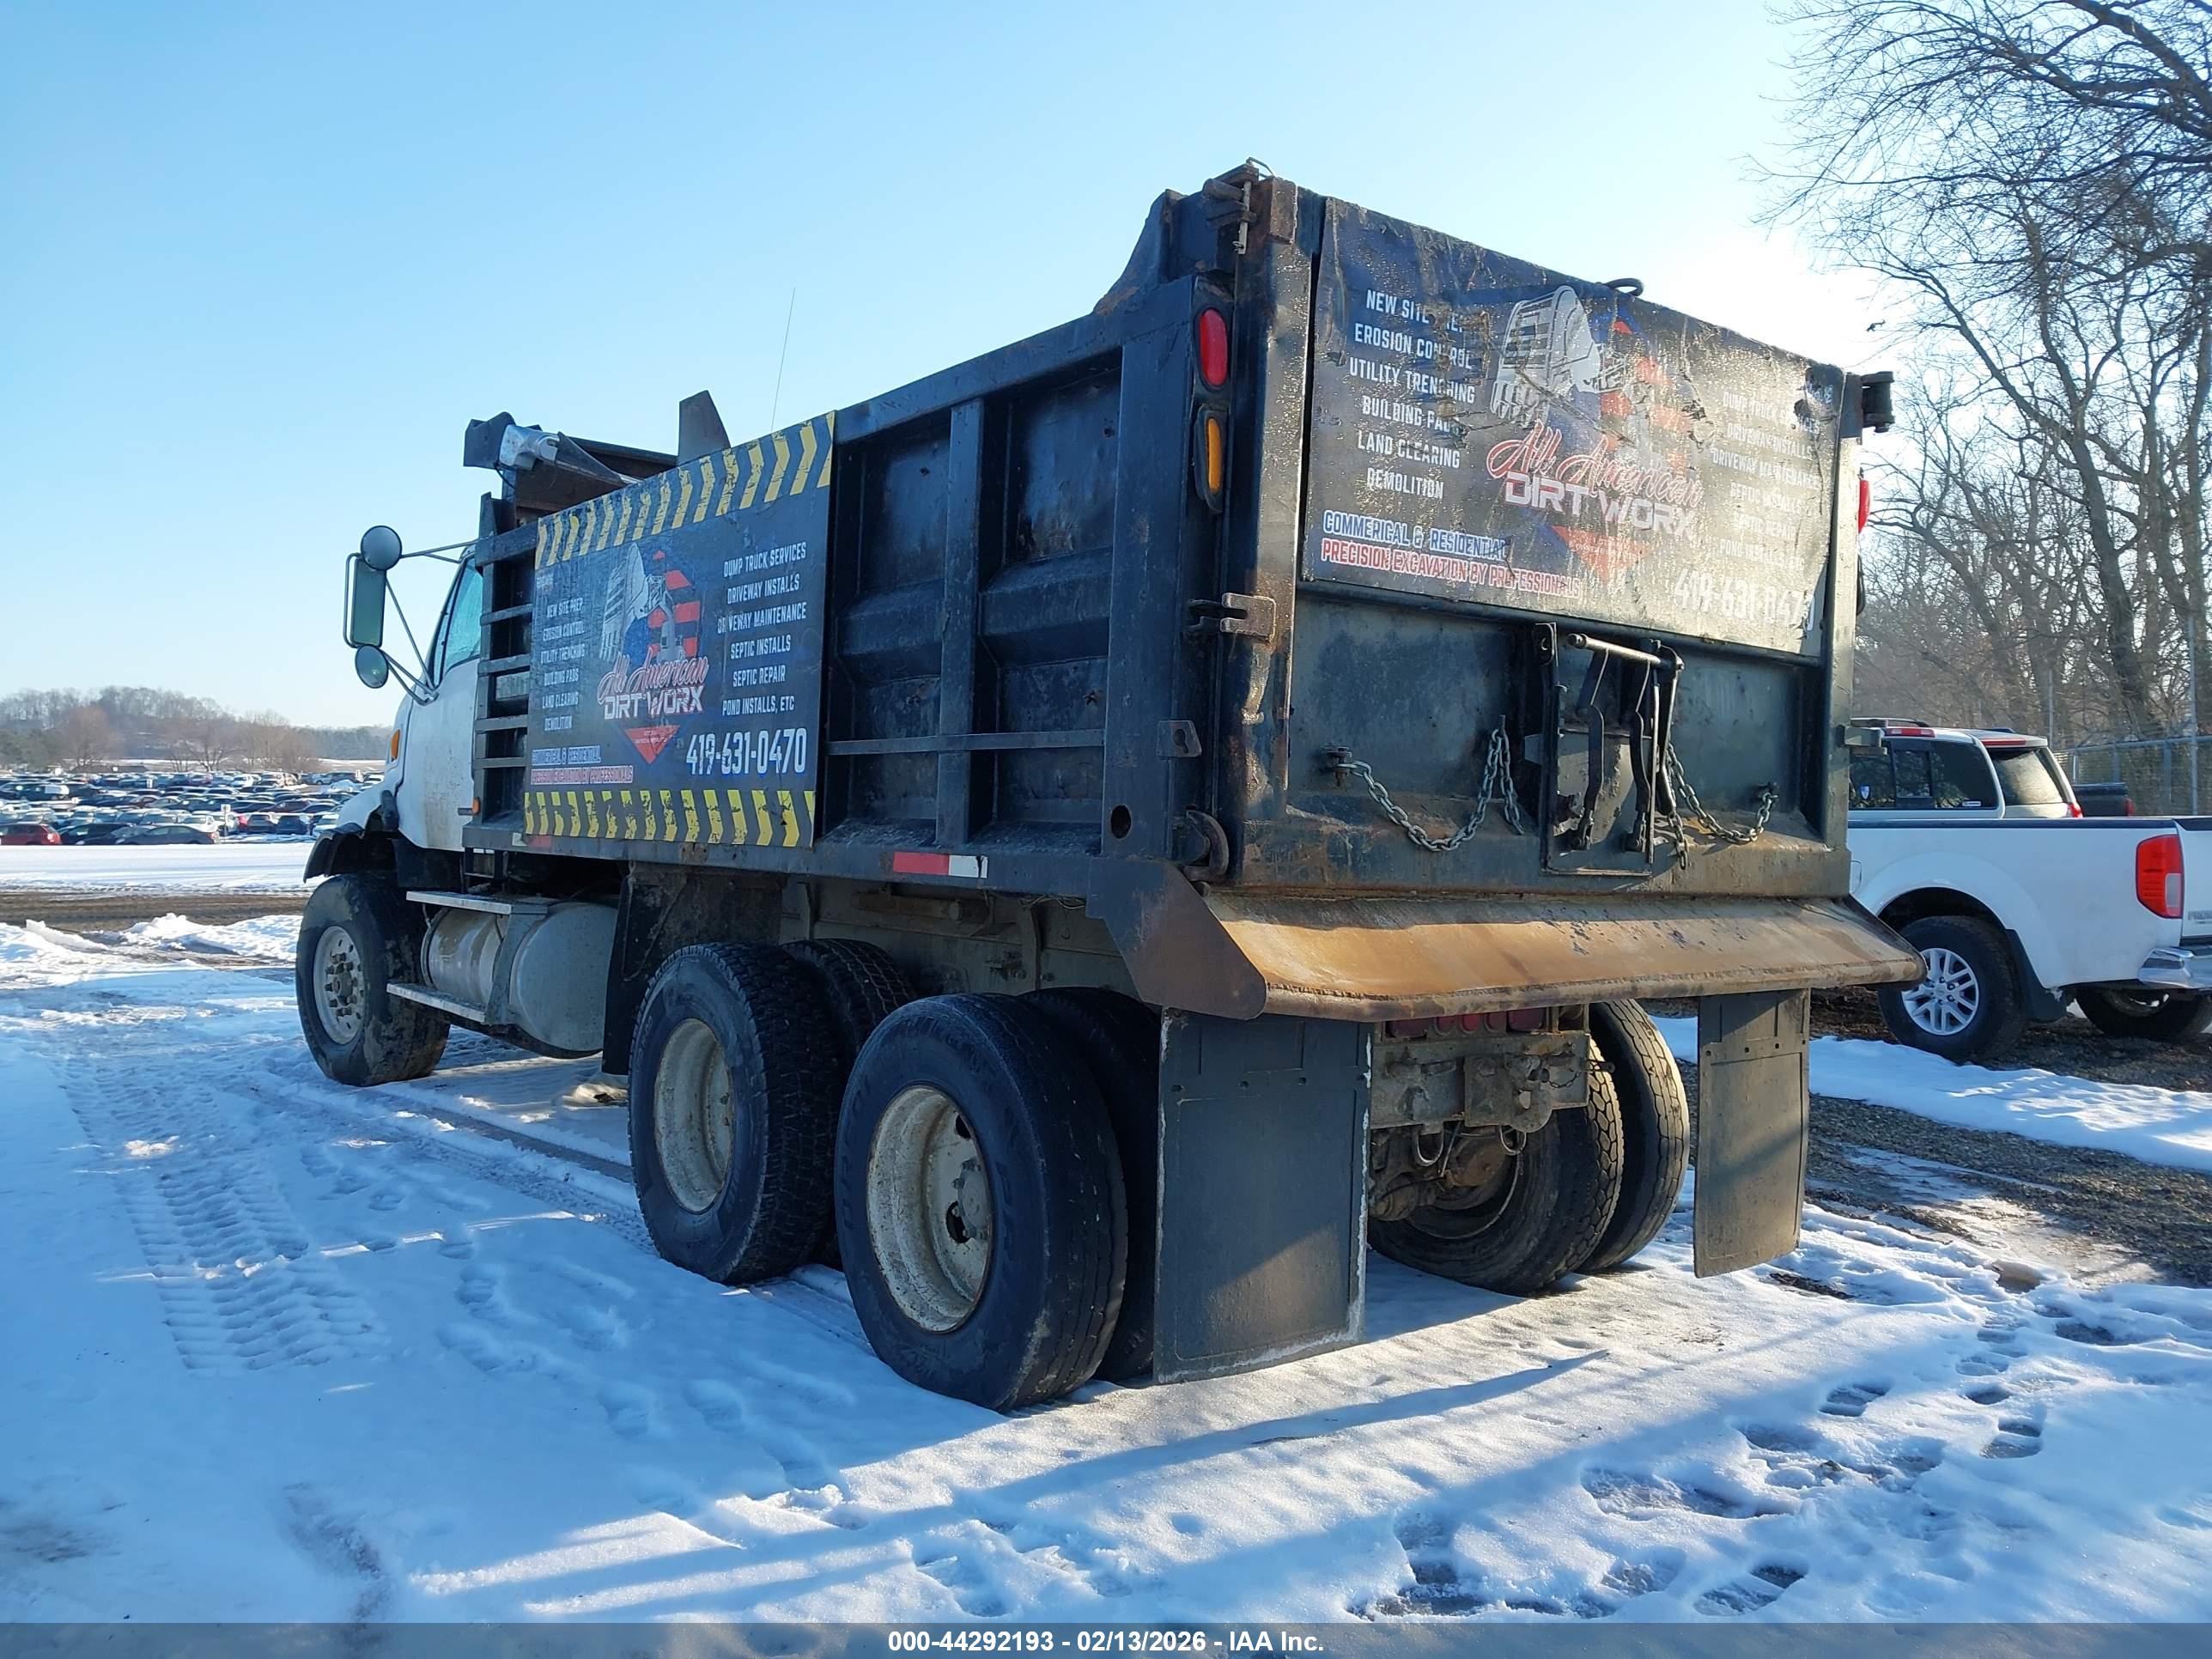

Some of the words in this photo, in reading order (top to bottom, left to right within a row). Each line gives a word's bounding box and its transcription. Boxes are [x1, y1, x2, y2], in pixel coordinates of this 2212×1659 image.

[1366, 289, 1397, 315] NEW
[1355, 323, 1412, 354] EROSION
[1417, 338, 1473, 370] CONROL
[1350, 357, 1401, 386] UTILITY
[1362, 395, 1423, 427] BUILDING
[1427, 410, 1461, 434] PAD
[1358, 430, 1394, 455] LAND
[1398, 440, 1460, 469] CLEARING
[1486, 419, 1563, 479] All
[1556, 434, 1705, 507] American
[1367, 467, 1444, 499] DEMOLITION
[1505, 471, 1590, 516] DIRT
[1598, 490, 1696, 541] WORX
[1323, 510, 1410, 547] COMMERICAL
[1430, 528, 1509, 561] RESIDENTIAL
[723, 557, 743, 578] DUMP
[744, 551, 769, 573] TRUCK
[769, 541, 806, 568] SERVICES
[1321, 538, 1393, 570] PRECISION
[1393, 551, 1468, 581] EXCAVATION
[1469, 561, 1487, 585] BY
[1488, 564, 1582, 599] PROFESSIONALS
[727, 580, 763, 605] DRIVEWAY
[764, 573, 800, 597] INSTALLS
[717, 611, 752, 634] DRVEWAY
[754, 602, 807, 628] MAINTENANCE
[730, 641, 755, 660] SEPTIC
[757, 634, 792, 655] INSTALLS
[597, 651, 629, 705] All
[626, 646, 709, 694] American
[732, 669, 757, 687] SEPTIC
[758, 665, 786, 684] REPAIR
[604, 692, 643, 720] DIRT
[647, 685, 704, 715] WORX
[722, 699, 740, 716] POND
[742, 696, 778, 714] INSTALLS,
[780, 696, 795, 711] ETC
[686, 727, 807, 775] 419-631-0470
